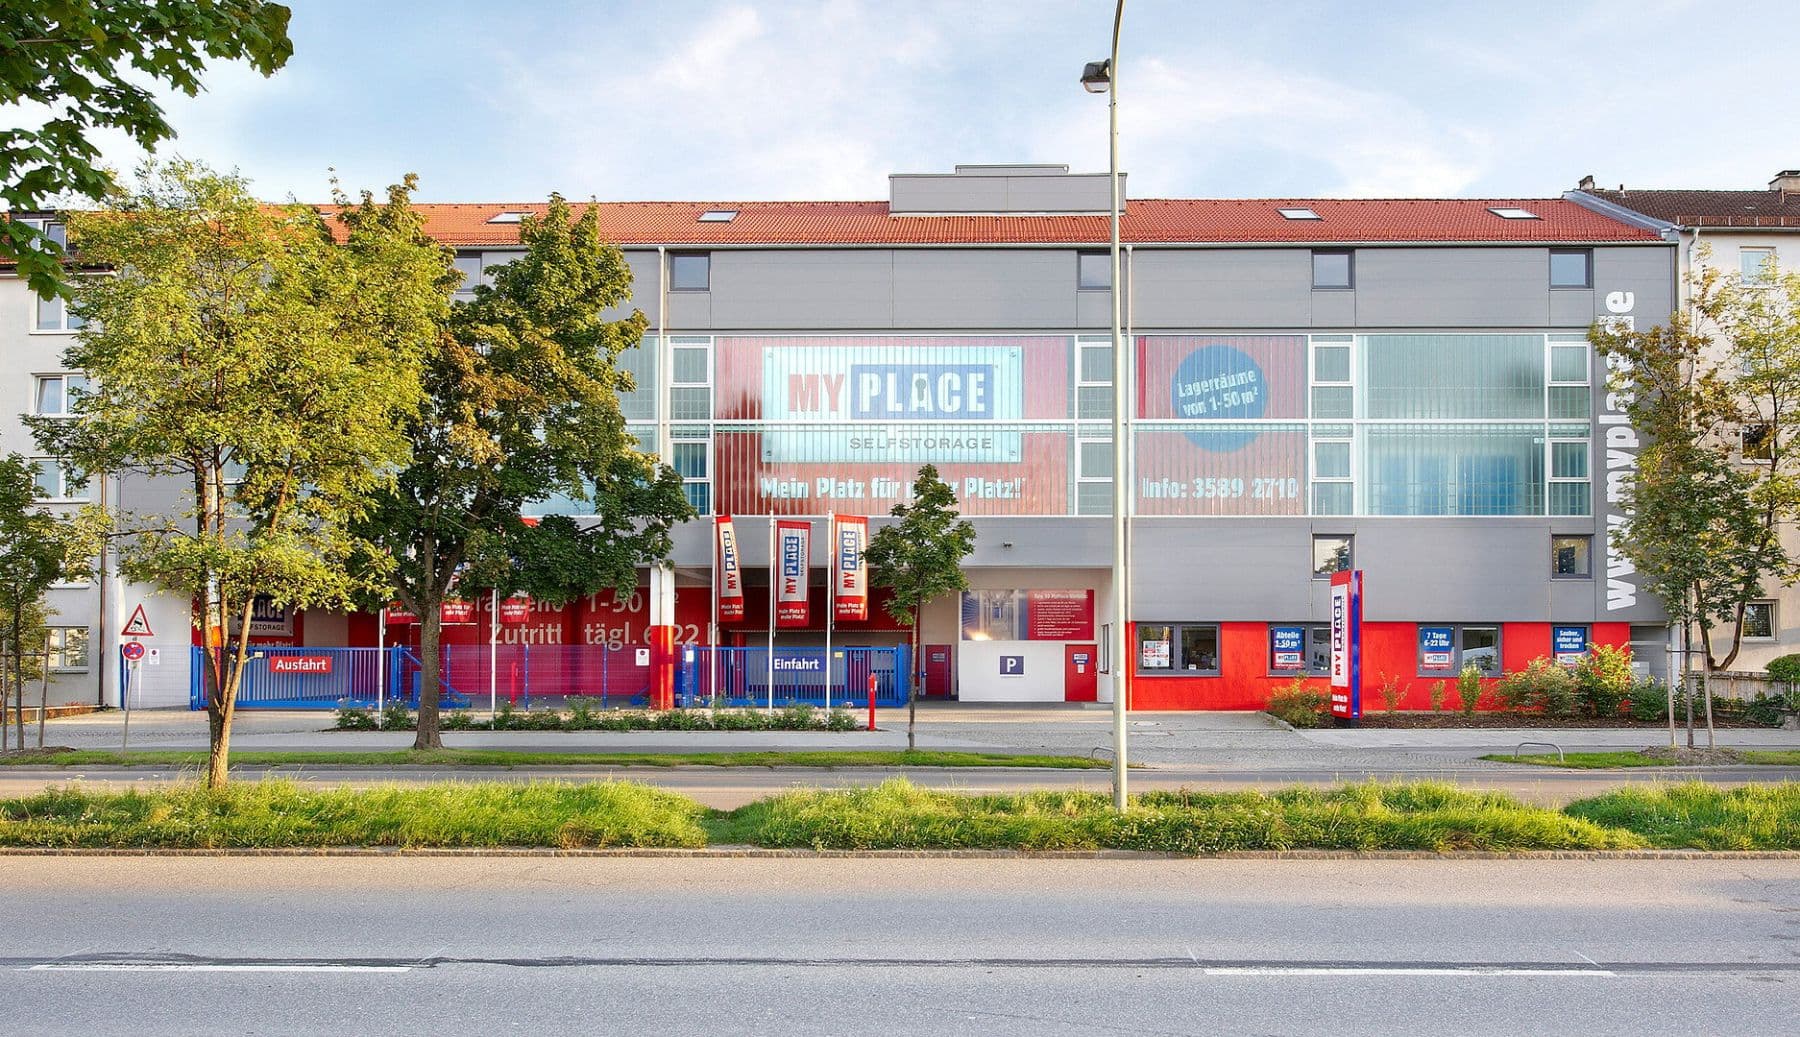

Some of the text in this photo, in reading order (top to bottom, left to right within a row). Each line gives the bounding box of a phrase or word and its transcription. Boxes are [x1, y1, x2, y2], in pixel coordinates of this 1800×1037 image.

[788, 372, 986, 414] MY PLACE
[1177, 370, 1257, 398] Lagerräume
[1182, 401, 1207, 416] von
[849, 437, 993, 450] SELFSTORAGE
[761, 477, 809, 499] Mein
[816, 477, 865, 499] Platz
[871, 477, 901, 499] für
[964, 477, 1021, 499] Platz!
[1192, 477, 1244, 499] 3589
[785, 537, 799, 594] MY PLACE
[843, 531, 857, 589] MY PLACE
[727, 573, 737, 590] MY
[488, 622, 562, 645] Zutritt
[584, 621, 638, 652] tägl.
[1334, 595, 1342, 676] MY PLACE
[275, 658, 327, 671] Ausfahrt
[773, 658, 820, 671] Einfahrt
[1006, 658, 1017, 673] P
